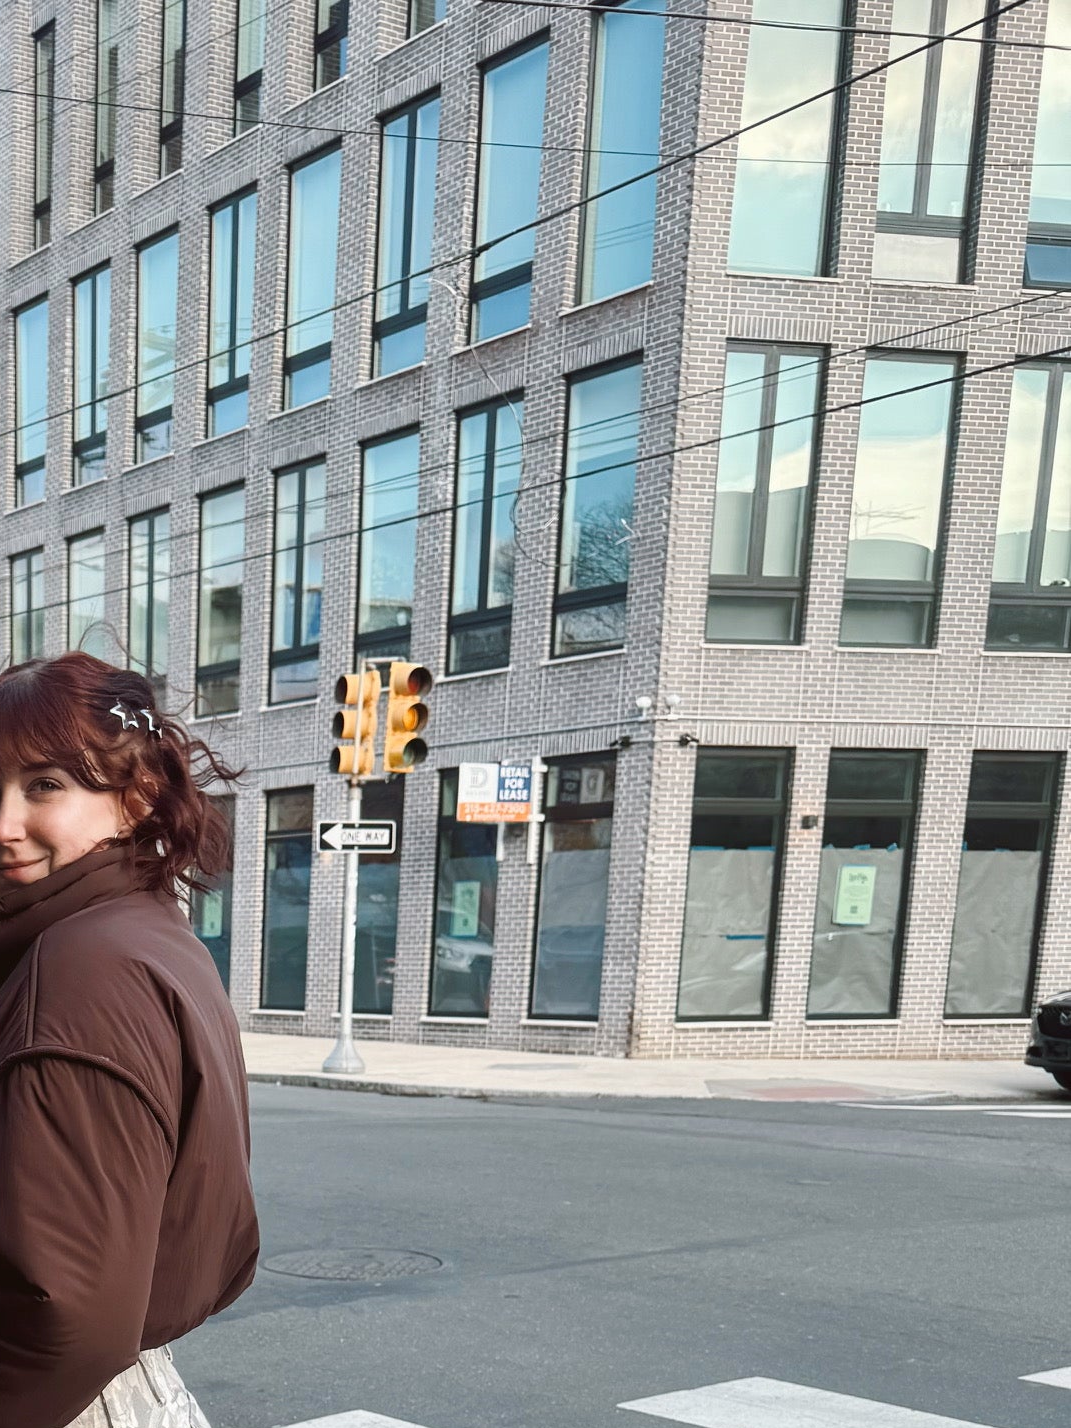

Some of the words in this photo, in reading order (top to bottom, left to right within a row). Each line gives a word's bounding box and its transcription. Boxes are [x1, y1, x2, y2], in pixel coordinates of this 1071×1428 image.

[500, 767, 530, 778] RETAIL
[505, 778, 524, 789] FOR
[499, 789, 528, 801] LEASE
[340, 831, 361, 843] ONE
[365, 832, 385, 841] WAY
